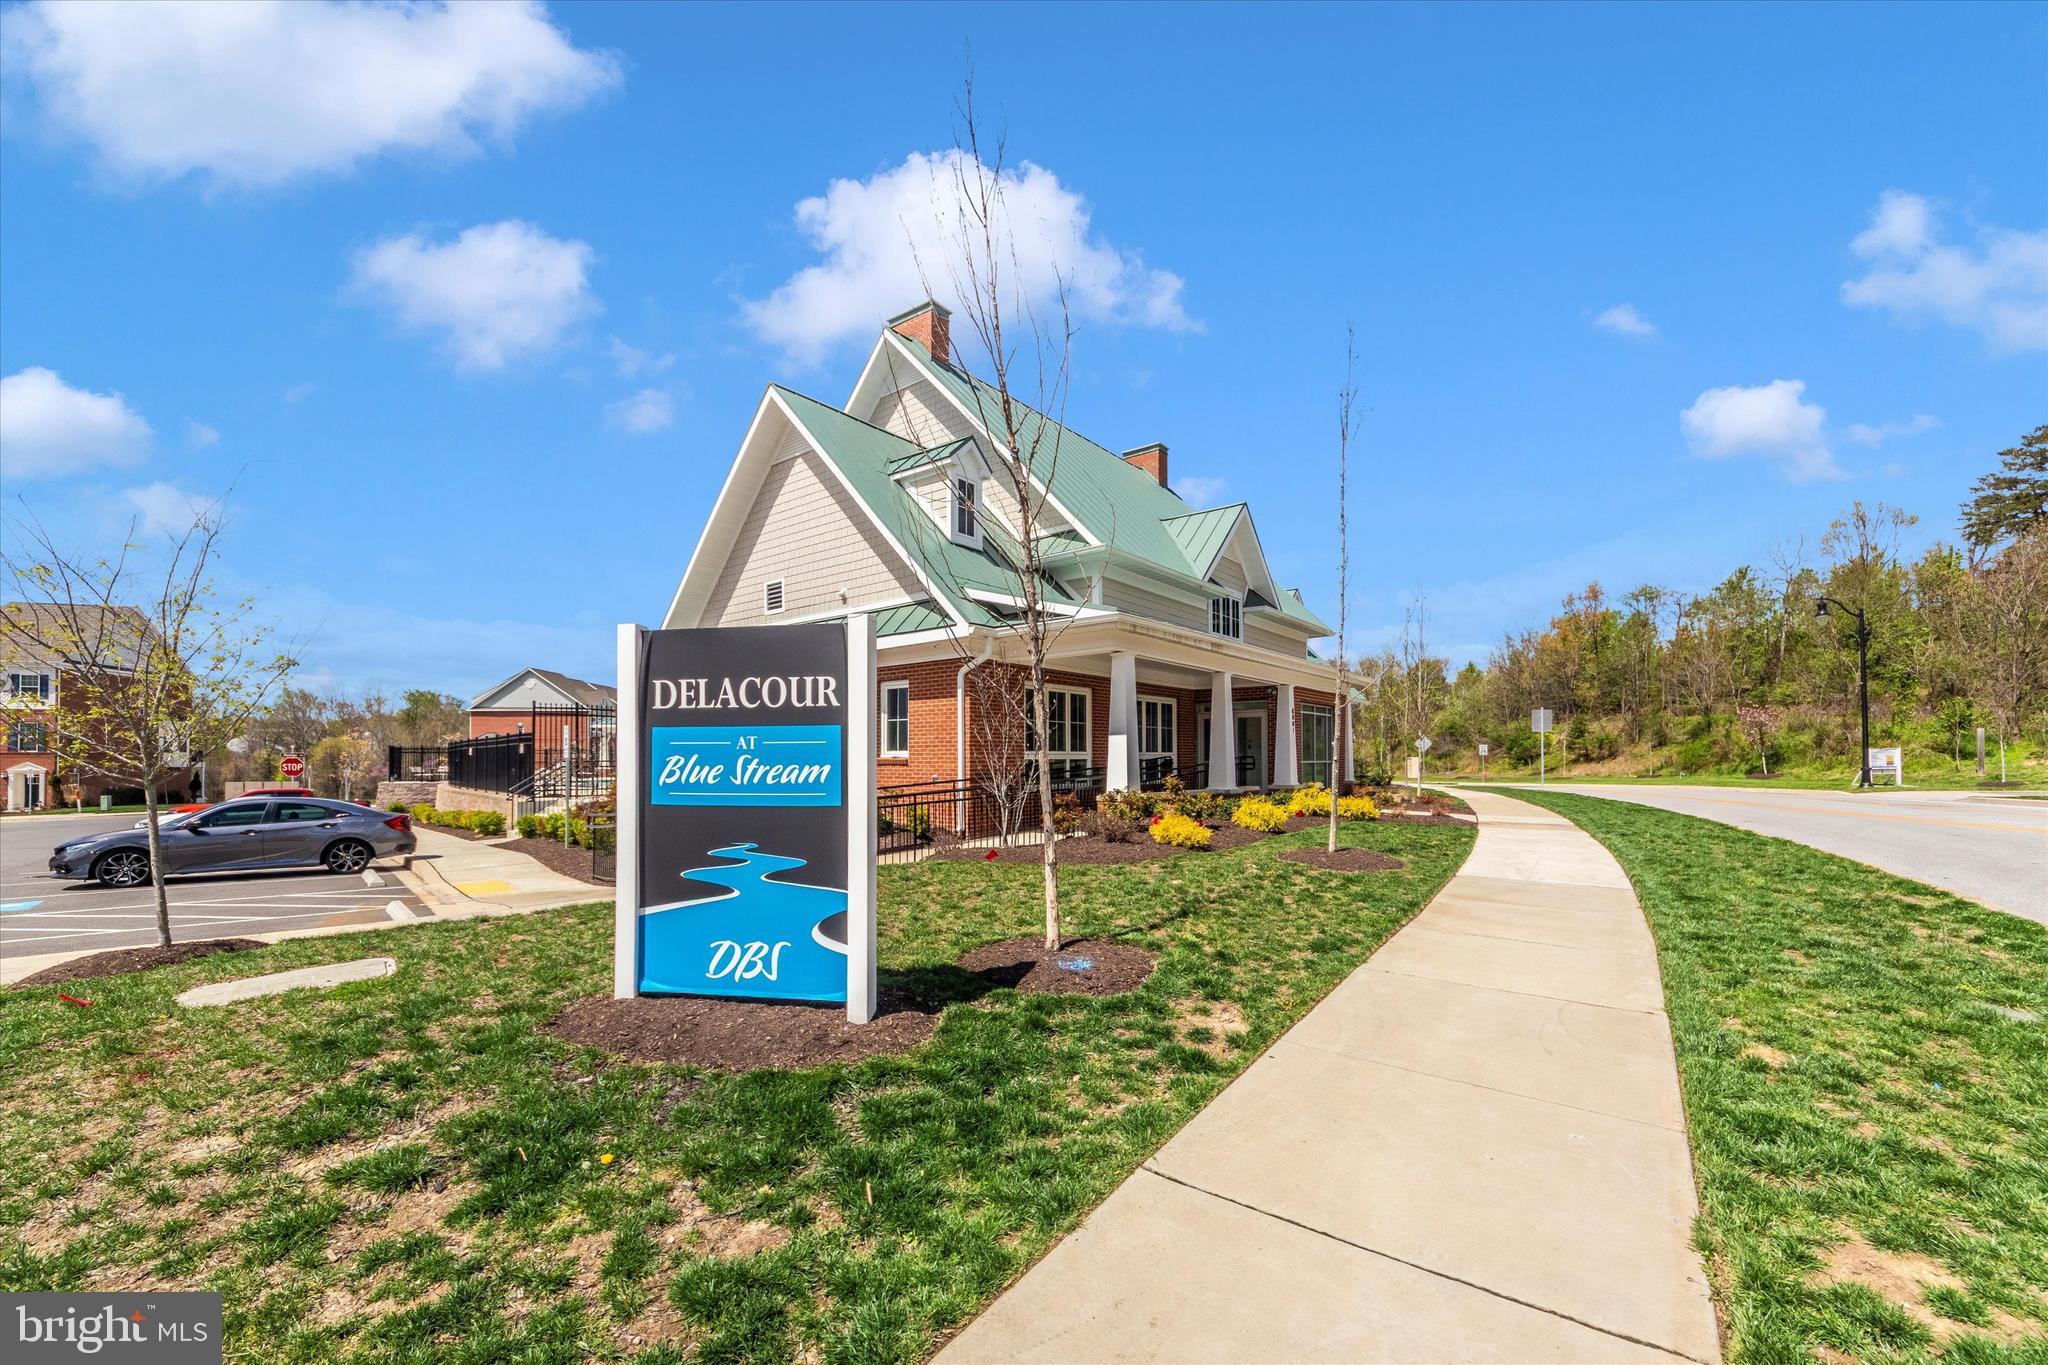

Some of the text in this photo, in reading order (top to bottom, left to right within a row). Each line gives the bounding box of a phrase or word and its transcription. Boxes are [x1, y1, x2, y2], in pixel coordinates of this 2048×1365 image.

[652, 676, 841, 710] DELACOUR
[736, 735, 758, 750] AT
[282, 763, 303, 771] STOP
[658, 753, 832, 787] Blue Stream
[705, 940, 792, 983] DBS
